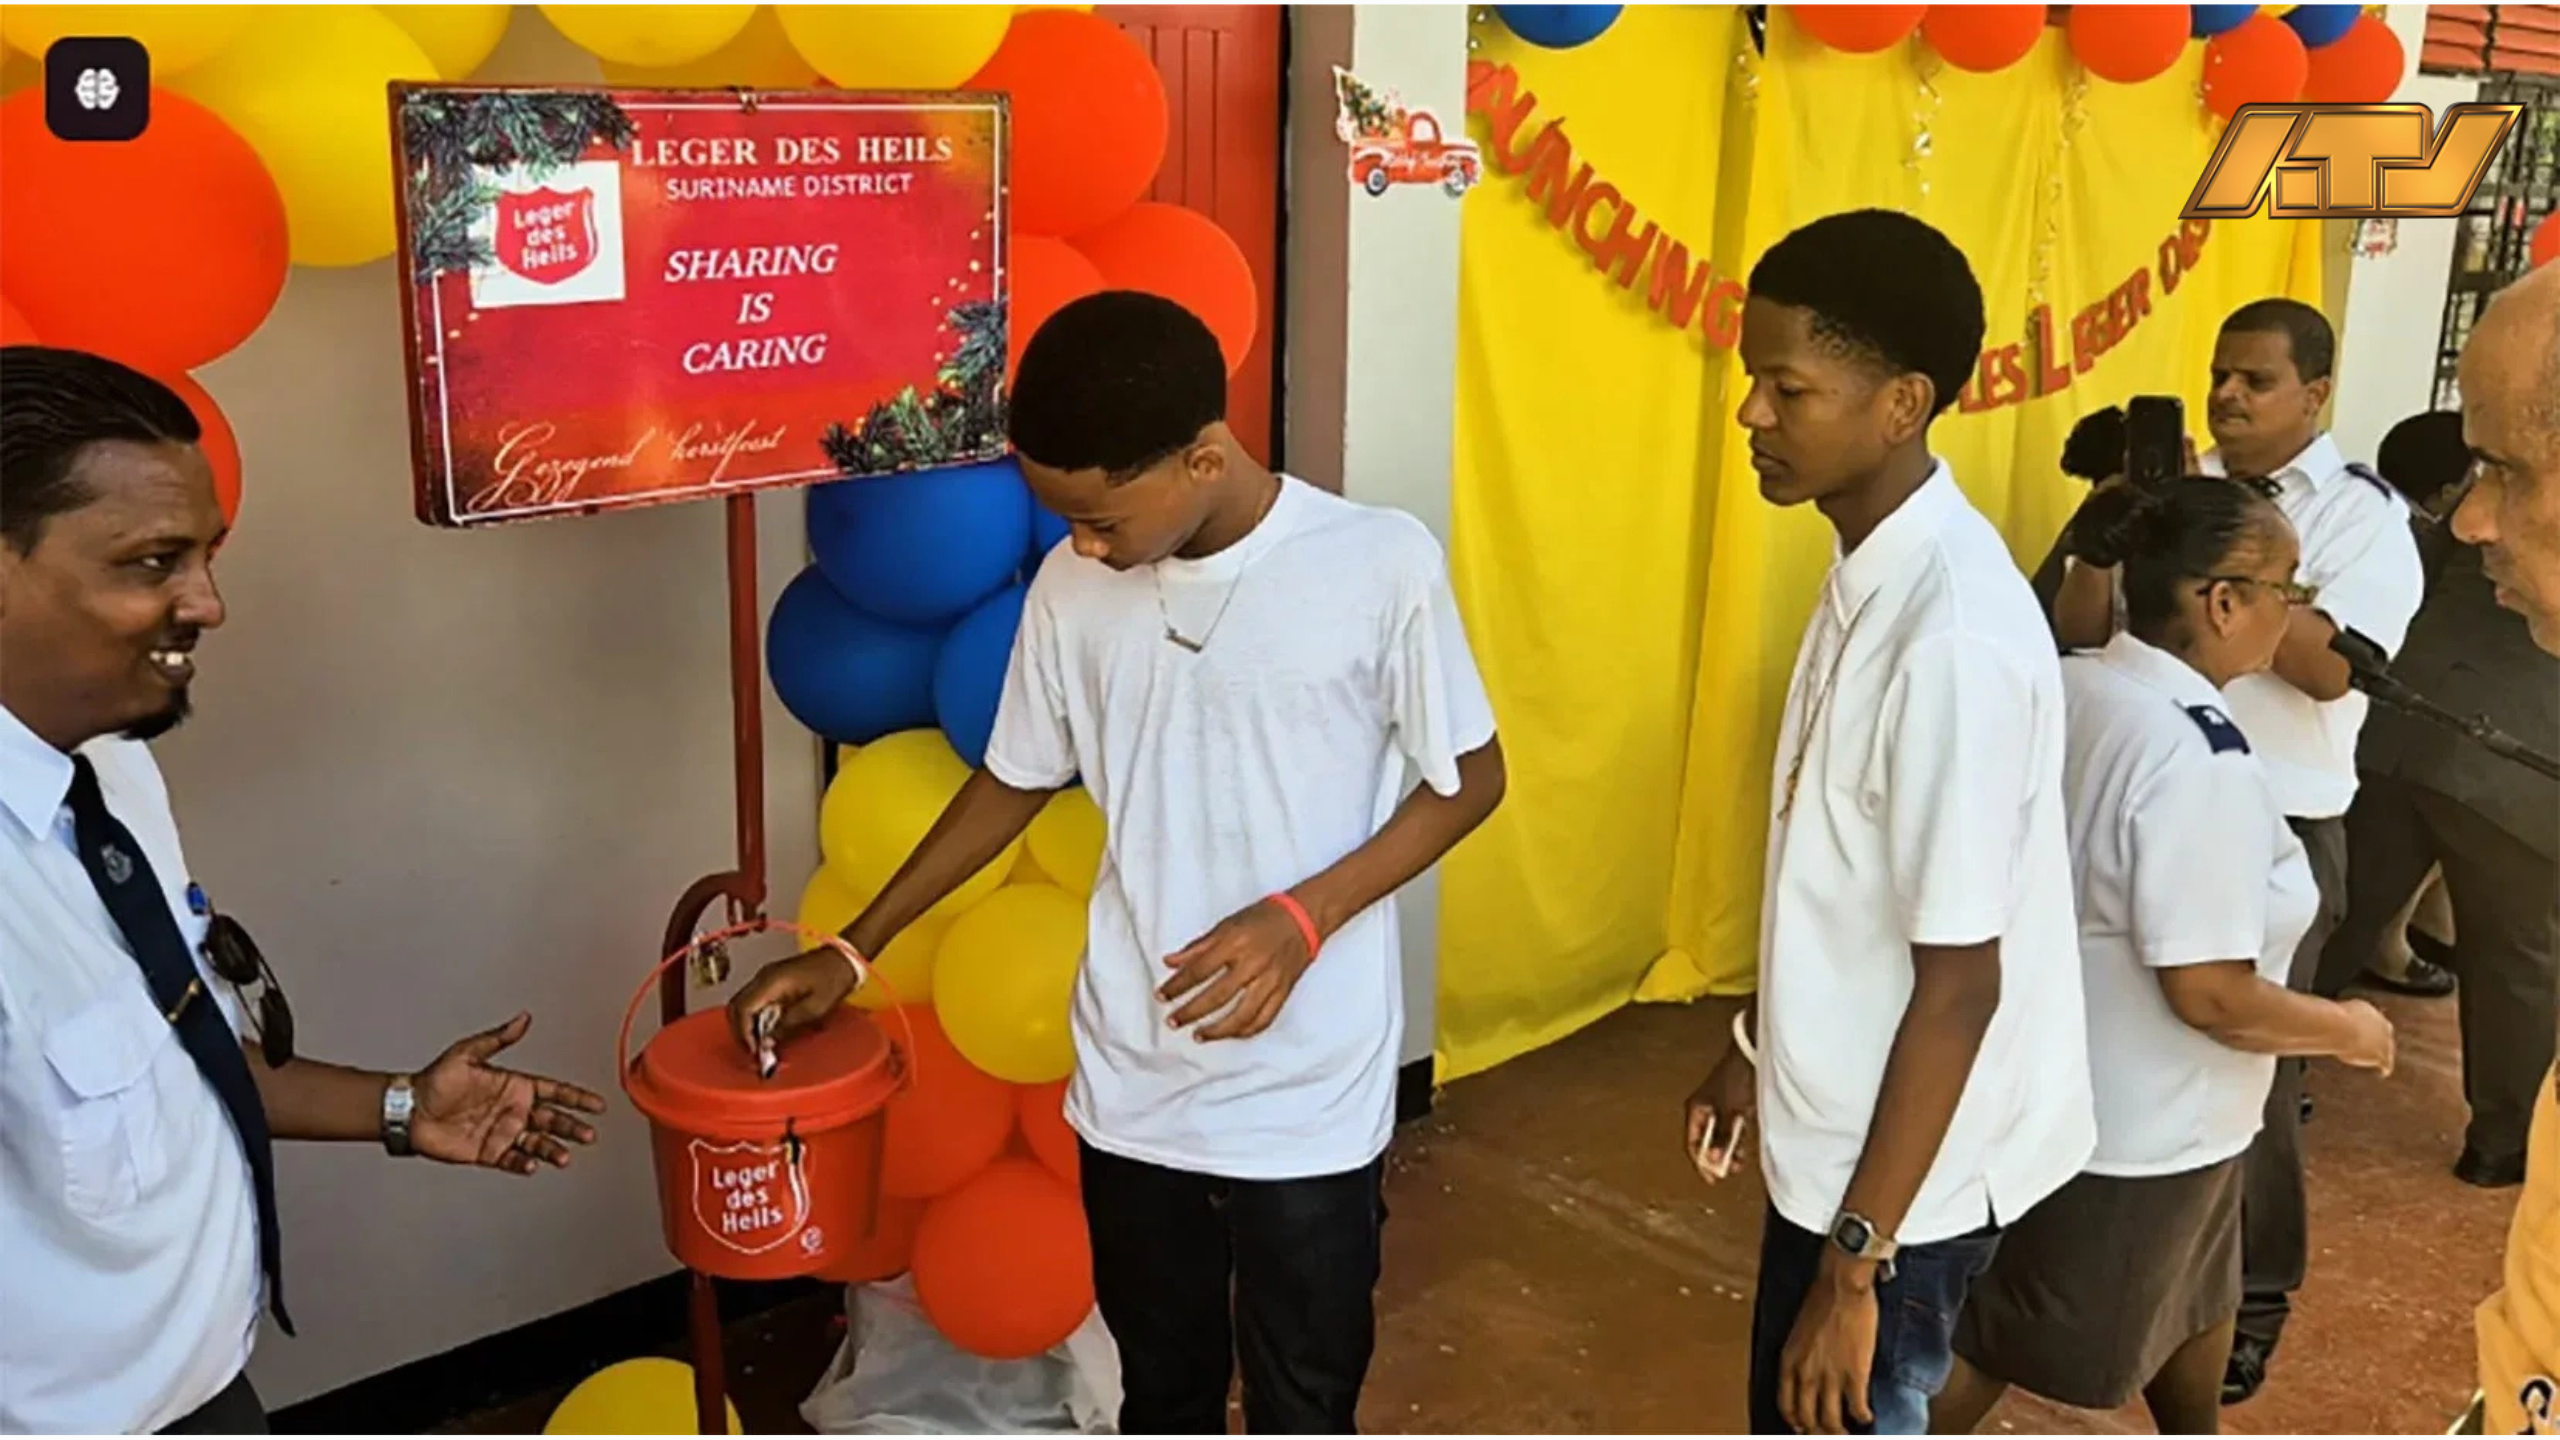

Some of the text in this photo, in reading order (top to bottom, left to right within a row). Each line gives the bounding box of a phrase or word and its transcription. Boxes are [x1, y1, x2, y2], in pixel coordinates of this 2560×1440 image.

[631, 136, 954, 166] LEGER DES HEILS
[666, 172, 914, 200] SURINAME DISTRICT
[514, 202, 576, 230] Leger
[1467, 60, 1745, 349] AUNCHING
[526, 226, 567, 247] des
[521, 243, 579, 270] Heils
[664, 243, 840, 282] SHARING
[735, 291, 774, 326] IS
[682, 333, 828, 375] CARING
[1957, 342, 2029, 415] LES
[712, 1159, 781, 1189] Leger
[726, 1186, 769, 1209] des
[722, 1207, 784, 1234] Heils
